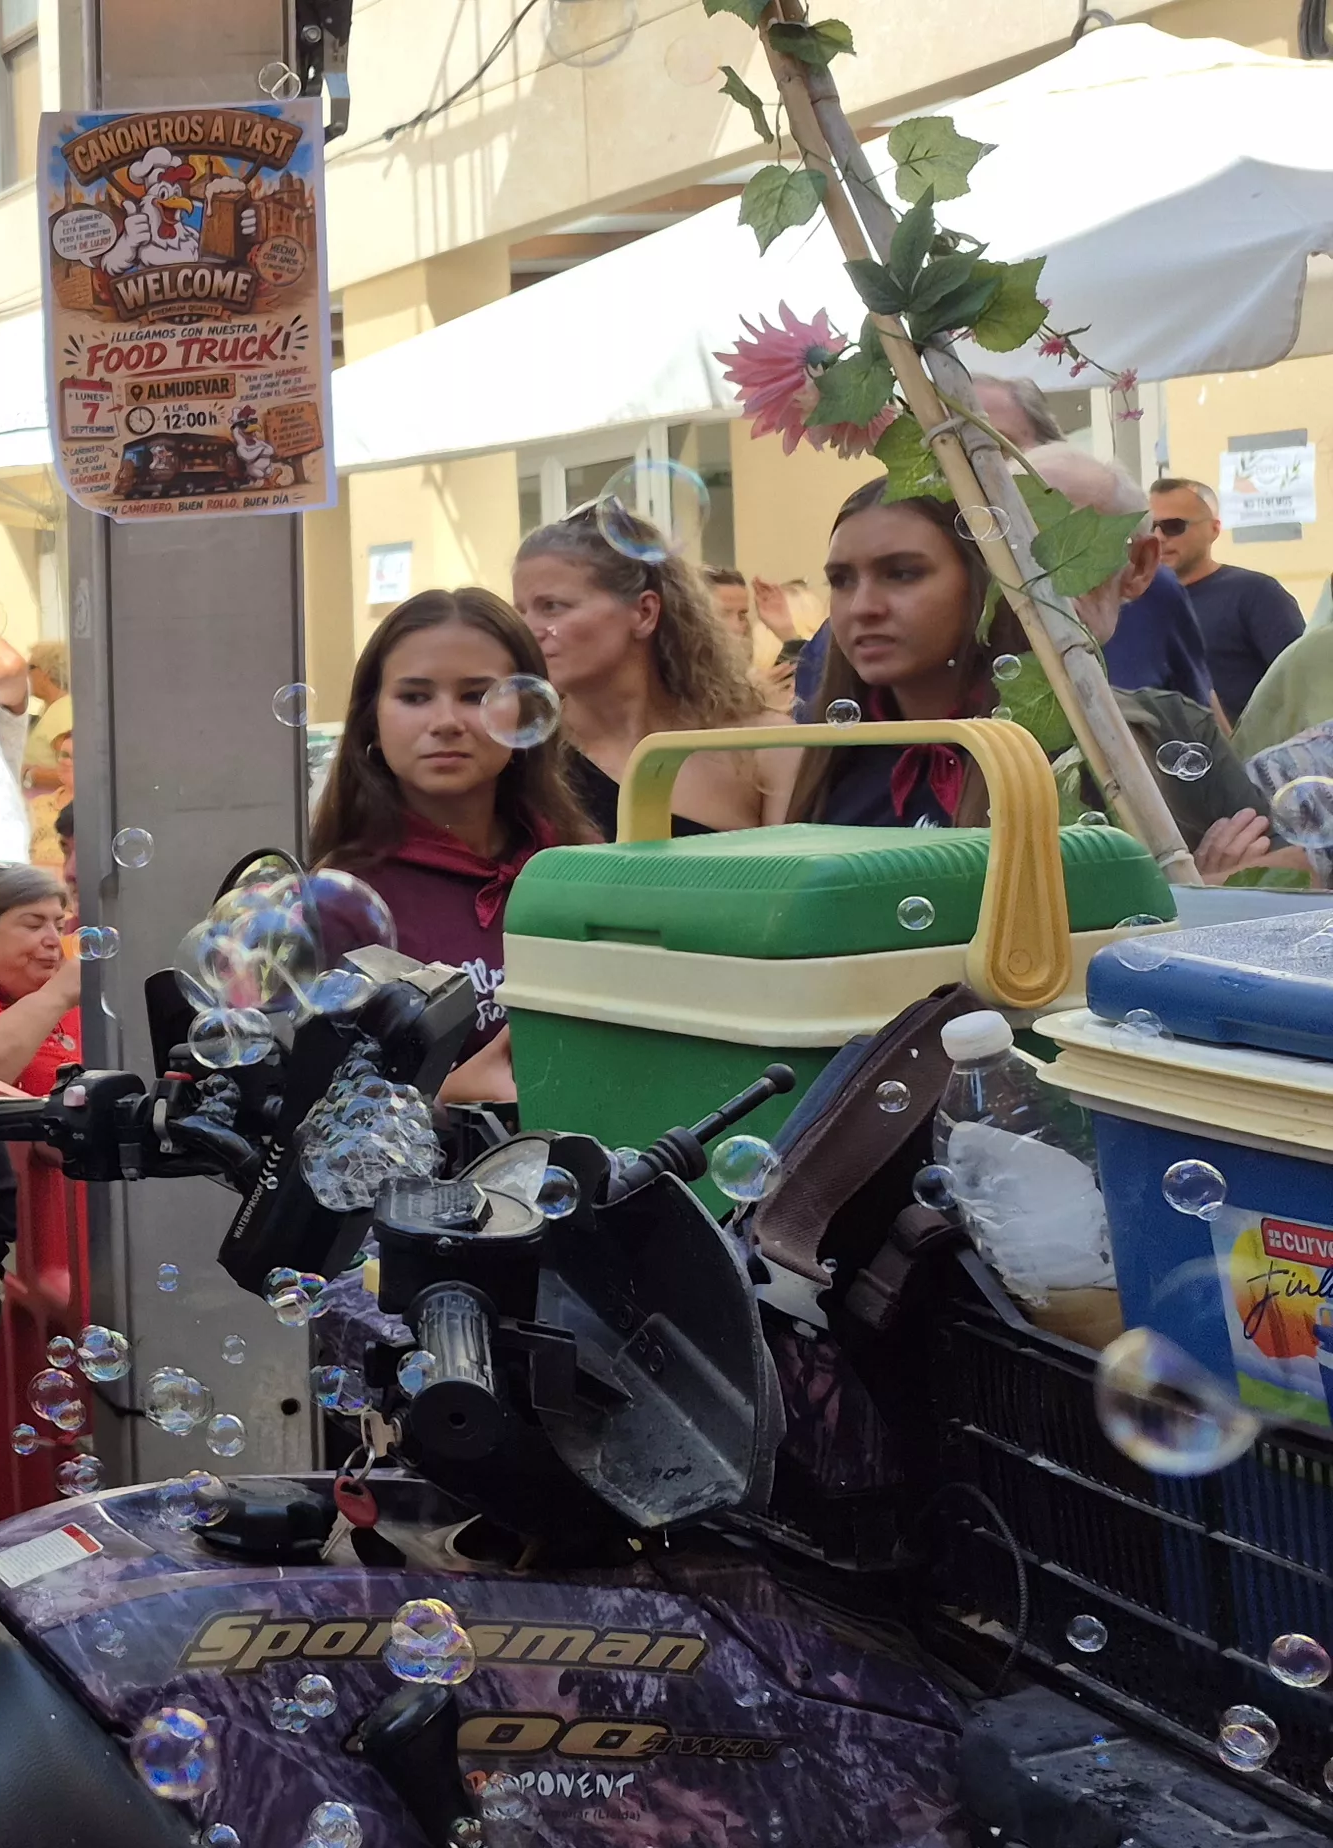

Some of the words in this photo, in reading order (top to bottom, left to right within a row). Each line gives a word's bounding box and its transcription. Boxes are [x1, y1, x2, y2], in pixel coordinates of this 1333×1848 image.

[73, 117, 205, 173] CAÑONEROS
[209, 115, 226, 143] A
[230, 118, 294, 160] L'AST
[116, 268, 252, 310] WELCOME
[110, 328, 176, 344] ¡LLEGAMOS
[180, 327, 203, 337] CON
[208, 323, 258, 335] NUESTRA
[87, 341, 168, 377] FOOD
[176, 326, 292, 368] TRUCK!
[75, 393, 104, 402] LUNES
[147, 378, 230, 400] ALMUDEVAR
[82, 402, 100, 425] 7
[162, 405, 169, 413] A
[172, 404, 189, 412] LAS
[75, 455, 100, 465] ASADO
[178, 500, 203, 512] BUEN
[243, 496, 269, 507] BUEN
[272, 493, 289, 504] DÍA
